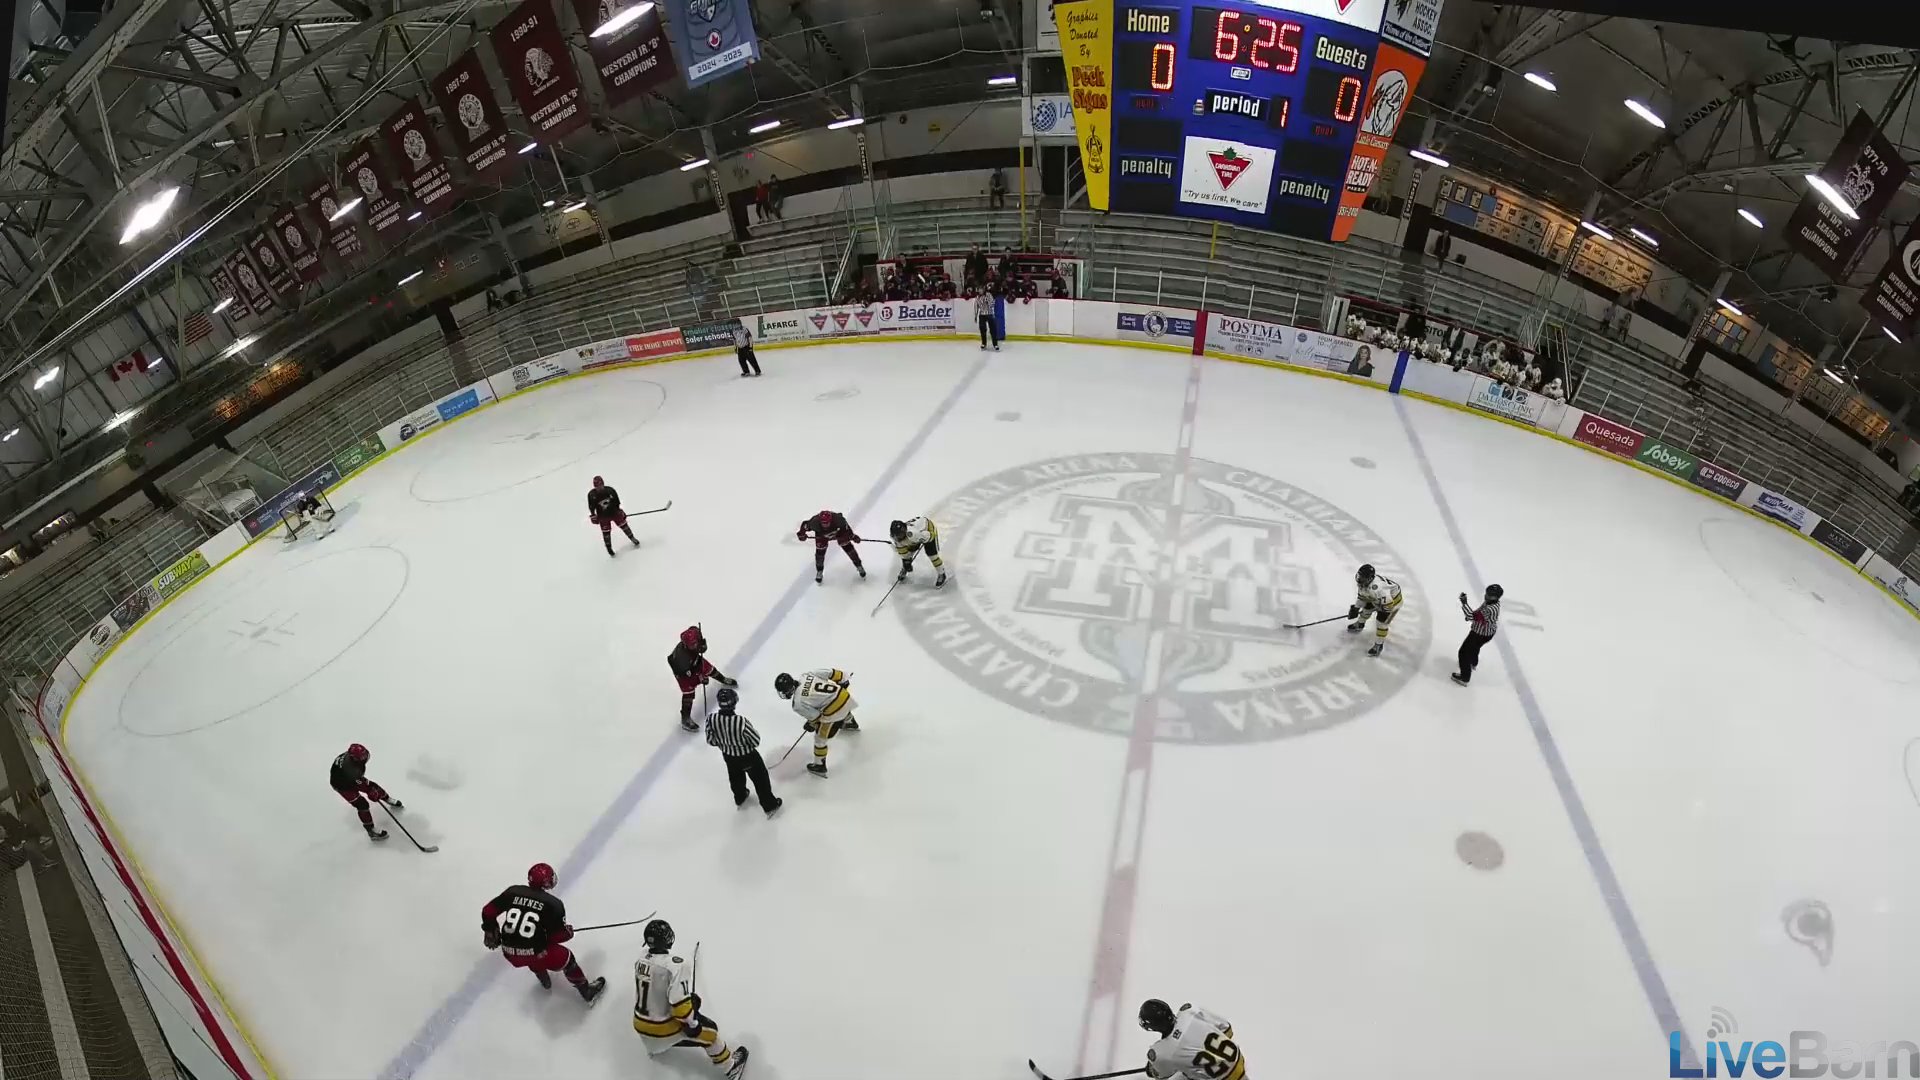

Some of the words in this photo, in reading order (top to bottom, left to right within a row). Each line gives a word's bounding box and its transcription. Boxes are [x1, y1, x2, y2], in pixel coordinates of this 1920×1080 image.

[510, 15, 539, 43] 1990-91
[1066, 9, 1098, 27] Graphics
[1127, 9, 1170, 33] Home
[1069, 28, 1099, 41] Donated
[1215, 10, 1301, 73] 6:25
[601, 50, 638, 77] WESTERN
[697, 59, 717, 74] 2024
[723, 48, 742, 62] 2025
[1080, 44, 1091, 58] By
[1315, 37, 1367, 70] Guests
[614, 55, 658, 86] CHAMPIONS
[1071, 65, 1106, 87] Peck
[1151, 43, 1175, 90] 0
[530, 99, 560, 123] WESTERN
[1073, 88, 1108, 114] Signs
[1212, 94, 1260, 117] period
[1334, 76, 1362, 122] 0
[541, 104, 577, 131] CHAMPIONS
[475, 148, 507, 171] CHAMPIONS
[1120, 157, 1172, 179] penalty
[1863, 144, 1889, 177] 977-78
[1279, 178, 1330, 203] penalty
[1346, 169, 1374, 187] READY
[1211, 193, 1228, 203] first,
[1230, 197, 1241, 205] we
[1800, 226, 1838, 260] CHAMPIONS
[1816, 219, 1840, 244] LEAGUE
[898, 304, 952, 320] Badder
[1876, 294, 1904, 321] CHAMPIONS
[685, 334, 703, 344] Safer
[704, 332, 733, 341] schools.
[762, 320, 798, 331] LAFARGE
[1221, 318, 1282, 340] POSTMA
[663, 338, 683, 348] DEPOT
[512, 366, 528, 377] FIRST
[1585, 421, 1635, 447] Quesada
[1022, 455, 1137, 484] ARENA
[1643, 444, 1691, 470] Sobeys
[158, 555, 195, 590] SUBWAY
[905, 588, 1081, 708] CHATHAM
[1214, 670, 1373, 732] ARENA
[512, 896, 544, 911] HAYNES
[504, 908, 540, 939] 96
[637, 962, 651, 977] HILL
[635, 978, 650, 1017] 11
